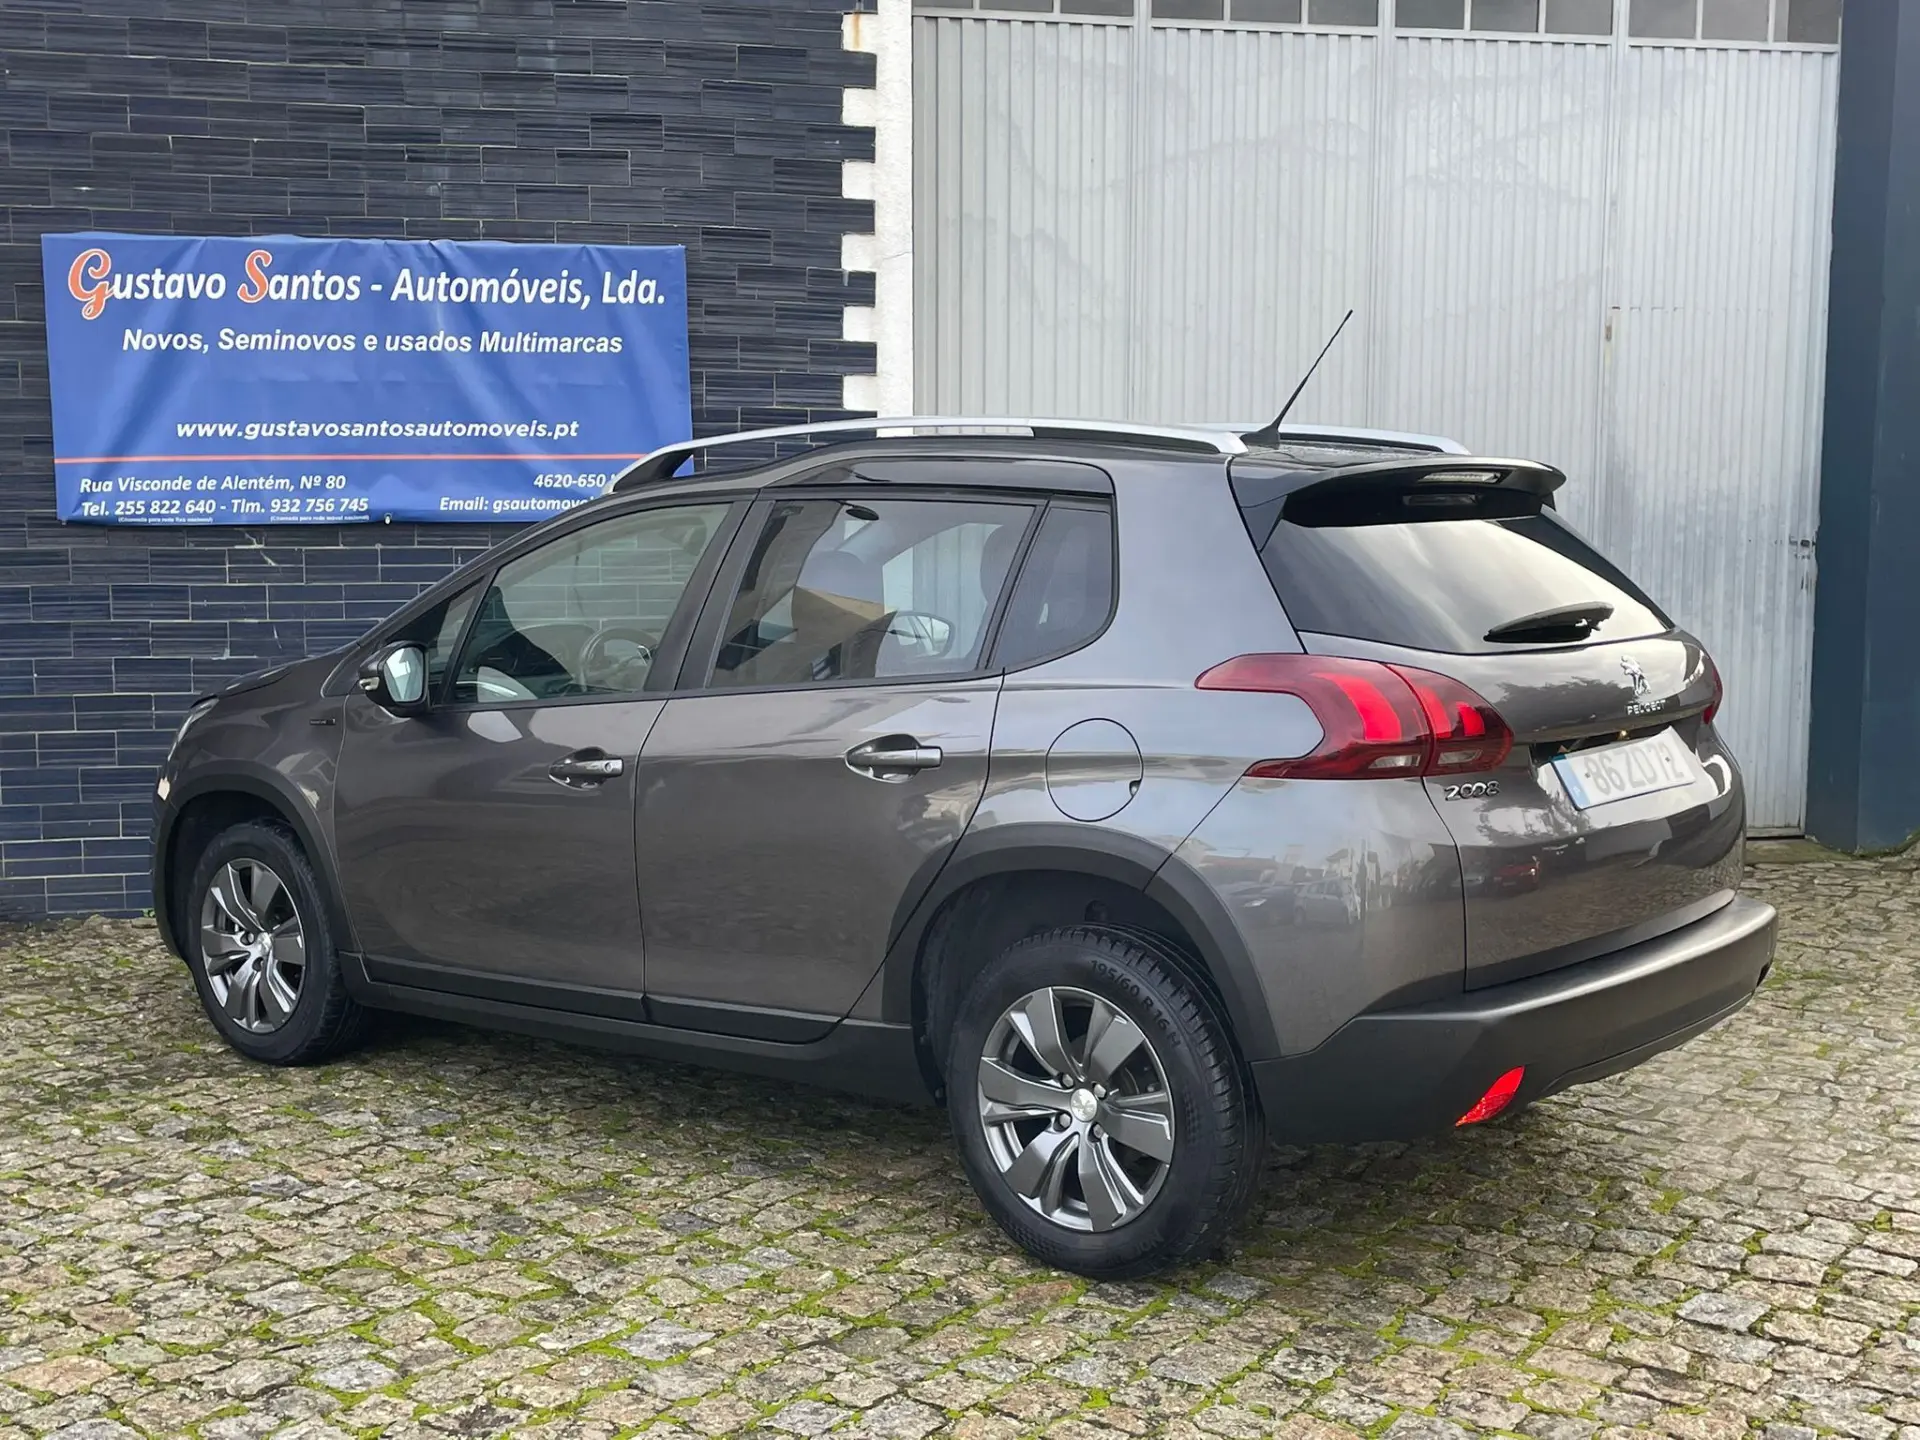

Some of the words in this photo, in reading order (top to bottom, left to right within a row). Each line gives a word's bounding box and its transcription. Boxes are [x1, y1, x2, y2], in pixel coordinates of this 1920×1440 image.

[68, 248, 226, 320] Gustavo
[237, 250, 361, 303] Santos
[371, 282, 383, 291] -
[390, 268, 592, 310] Automóveis,
[602, 269, 665, 304] Lda.
[122, 328, 209, 354] Novos,
[218, 327, 356, 352] Seminovos
[363, 334, 378, 351] e
[385, 330, 472, 352] usados
[479, 331, 623, 353] Multimarcas
[176, 420, 579, 440] www.gustavosantosautomoveis.pt
[80, 478, 113, 493] Rua
[118, 475, 192, 492] Visconde
[196, 475, 217, 491] de
[221, 474, 295, 492] Alentém,
[325, 475, 346, 490] 80
[533, 473, 606, 488] 4620-650
[82, 501, 110, 517] Tel.
[114, 500, 145, 516] 255
[150, 500, 180, 515] 822
[185, 499, 216, 514] 640
[231, 498, 266, 513] Tlm.
[270, 498, 300, 513] 932
[305, 498, 335, 513] 756
[340, 497, 369, 512] 745
[440, 496, 489, 511] Email:
[1444, 780, 1500, 801] 2008
